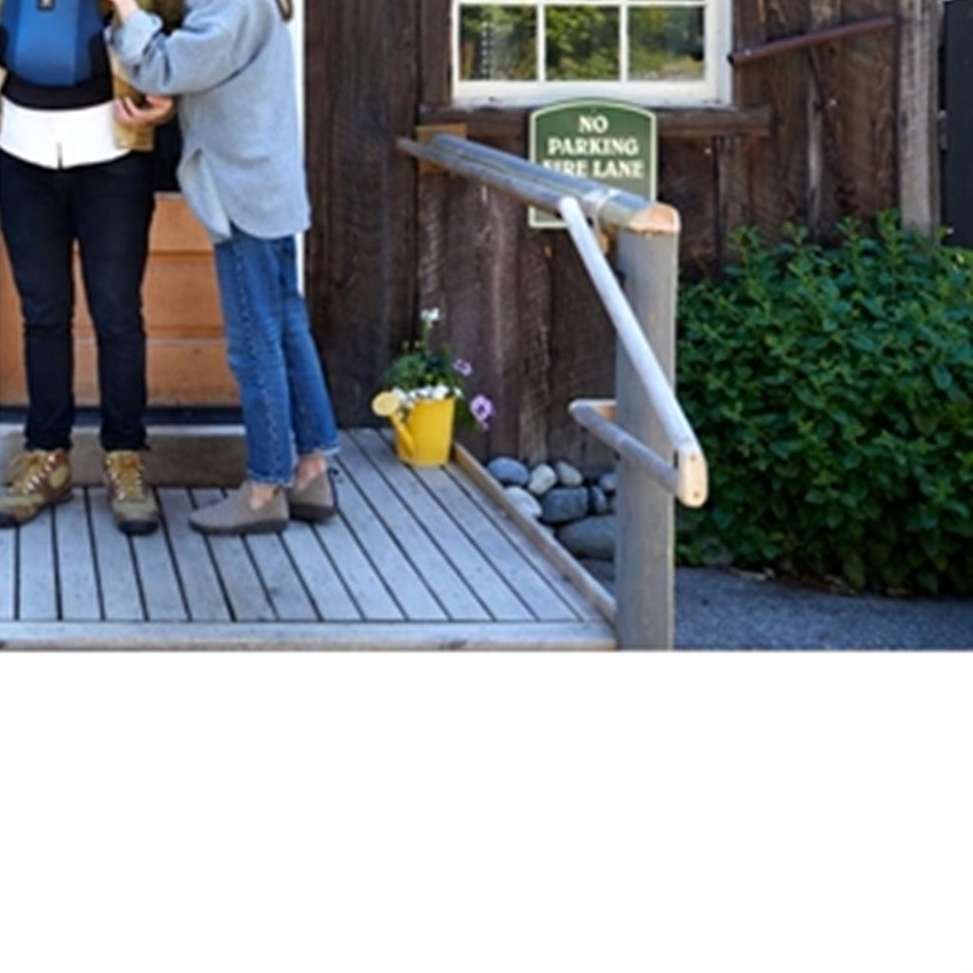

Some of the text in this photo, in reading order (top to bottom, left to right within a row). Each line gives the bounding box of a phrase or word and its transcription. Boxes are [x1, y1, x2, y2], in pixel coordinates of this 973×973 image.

[578, 114, 609, 134] NO
[547, 137, 639, 156] PARKING
[592, 158, 644, 177] LANE
